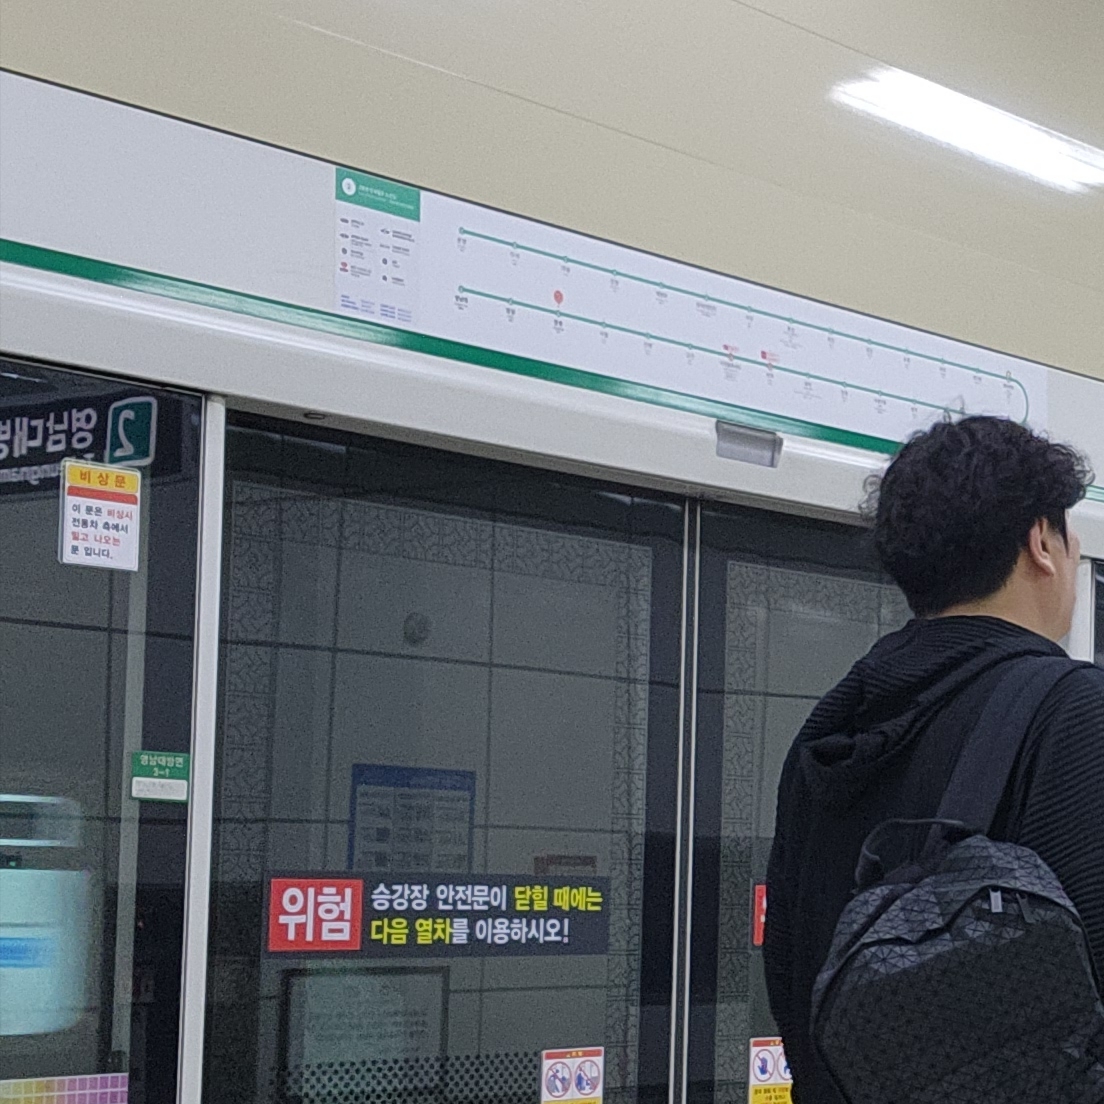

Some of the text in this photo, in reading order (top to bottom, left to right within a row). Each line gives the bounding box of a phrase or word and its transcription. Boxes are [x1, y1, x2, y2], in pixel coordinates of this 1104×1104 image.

[79, 469, 127, 489] 비상문
[71, 503, 134, 521] 이 문은 비상시
[71, 517, 99, 531] 전동차
[93, 533, 121, 547] 나오는
[278, 882, 604, 942] 위험 승강장 안전문이 닫힐 때에는
[370, 917, 570, 945] 다음 열차를 이용하시오!
